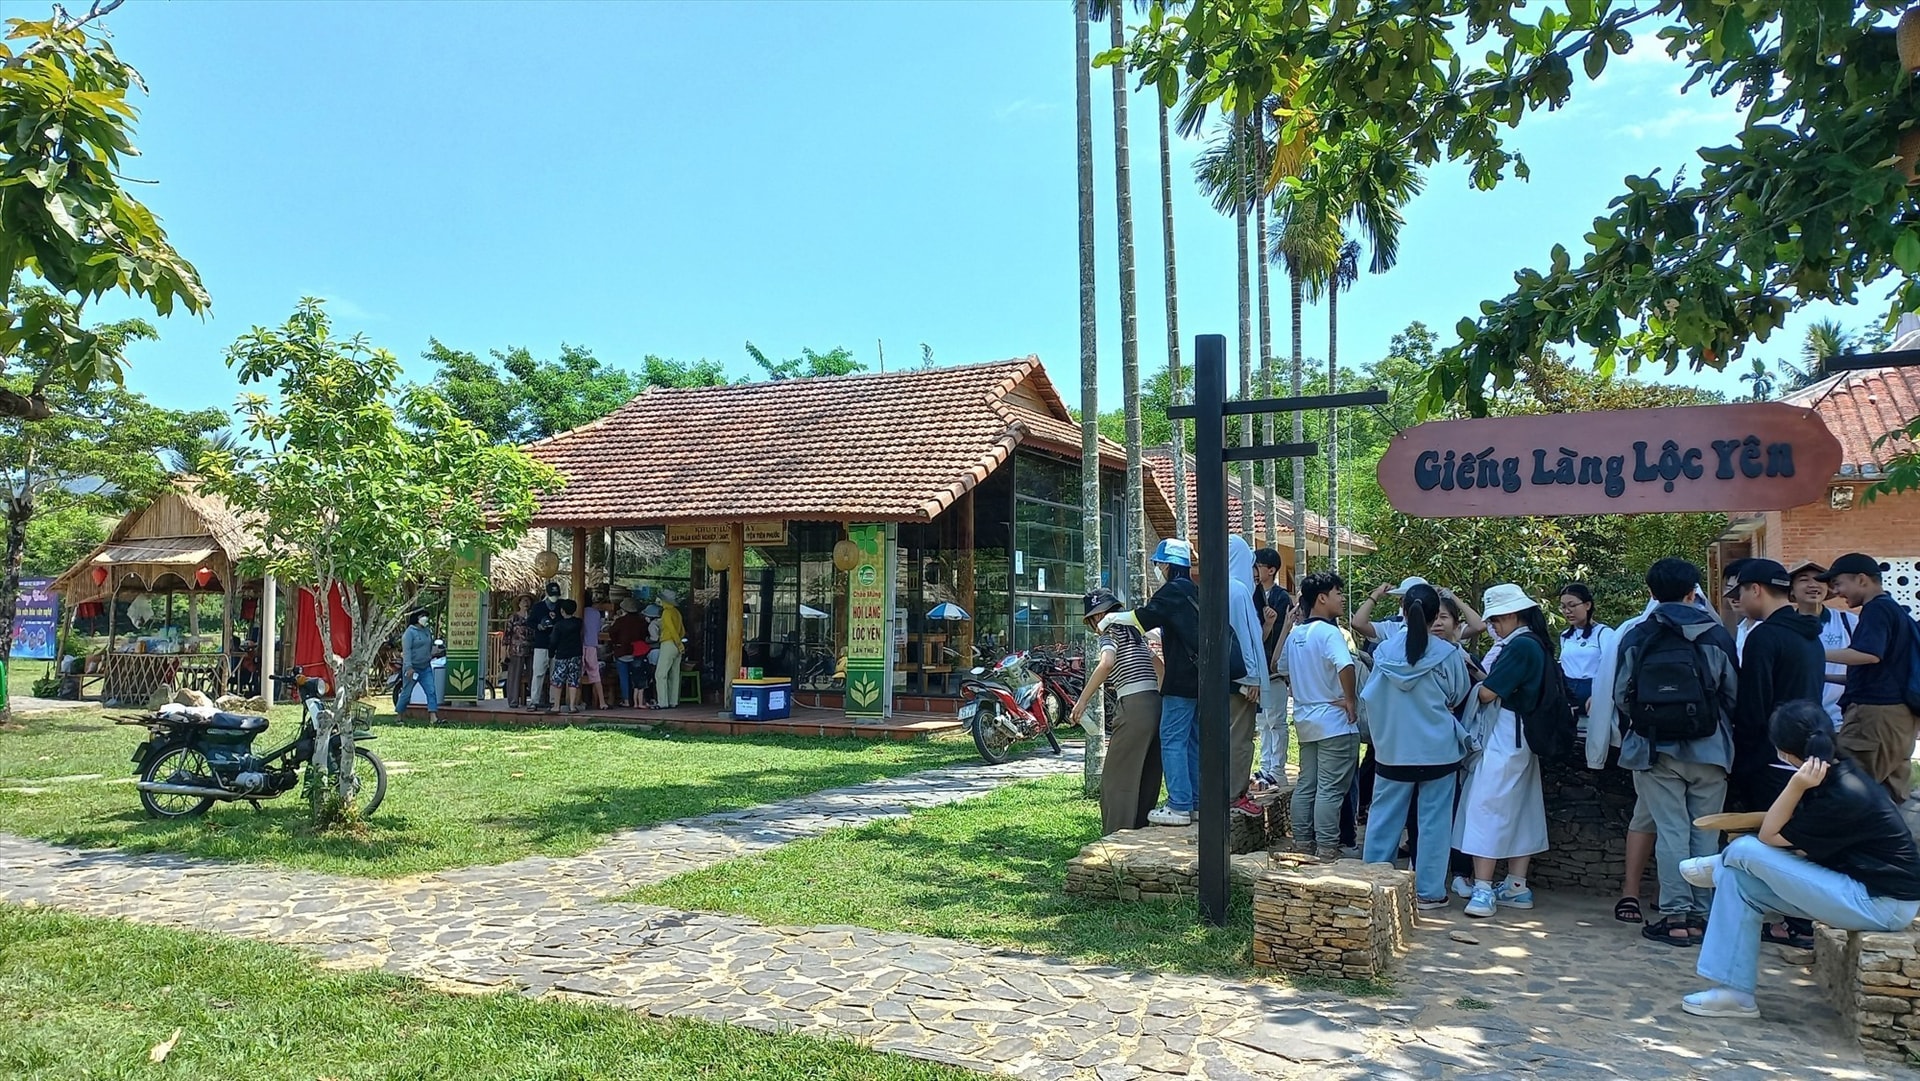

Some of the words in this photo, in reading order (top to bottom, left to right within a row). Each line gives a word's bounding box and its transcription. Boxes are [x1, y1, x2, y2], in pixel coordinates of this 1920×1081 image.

[1414, 447, 1522, 494] Giếng
[1531, 446, 1626, 499] Làng
[1632, 439, 1704, 494] Lộc
[1711, 434, 1796, 480] Yên
[853, 590, 866, 598] Chào
[866, 590, 881, 599] Mừng
[852, 603, 863, 621] HỘI
[865, 603, 881, 619] LÀNG
[852, 623, 865, 643] LỘC
[866, 623, 881, 641] YÊN
[853, 645, 863, 654] LẦN
